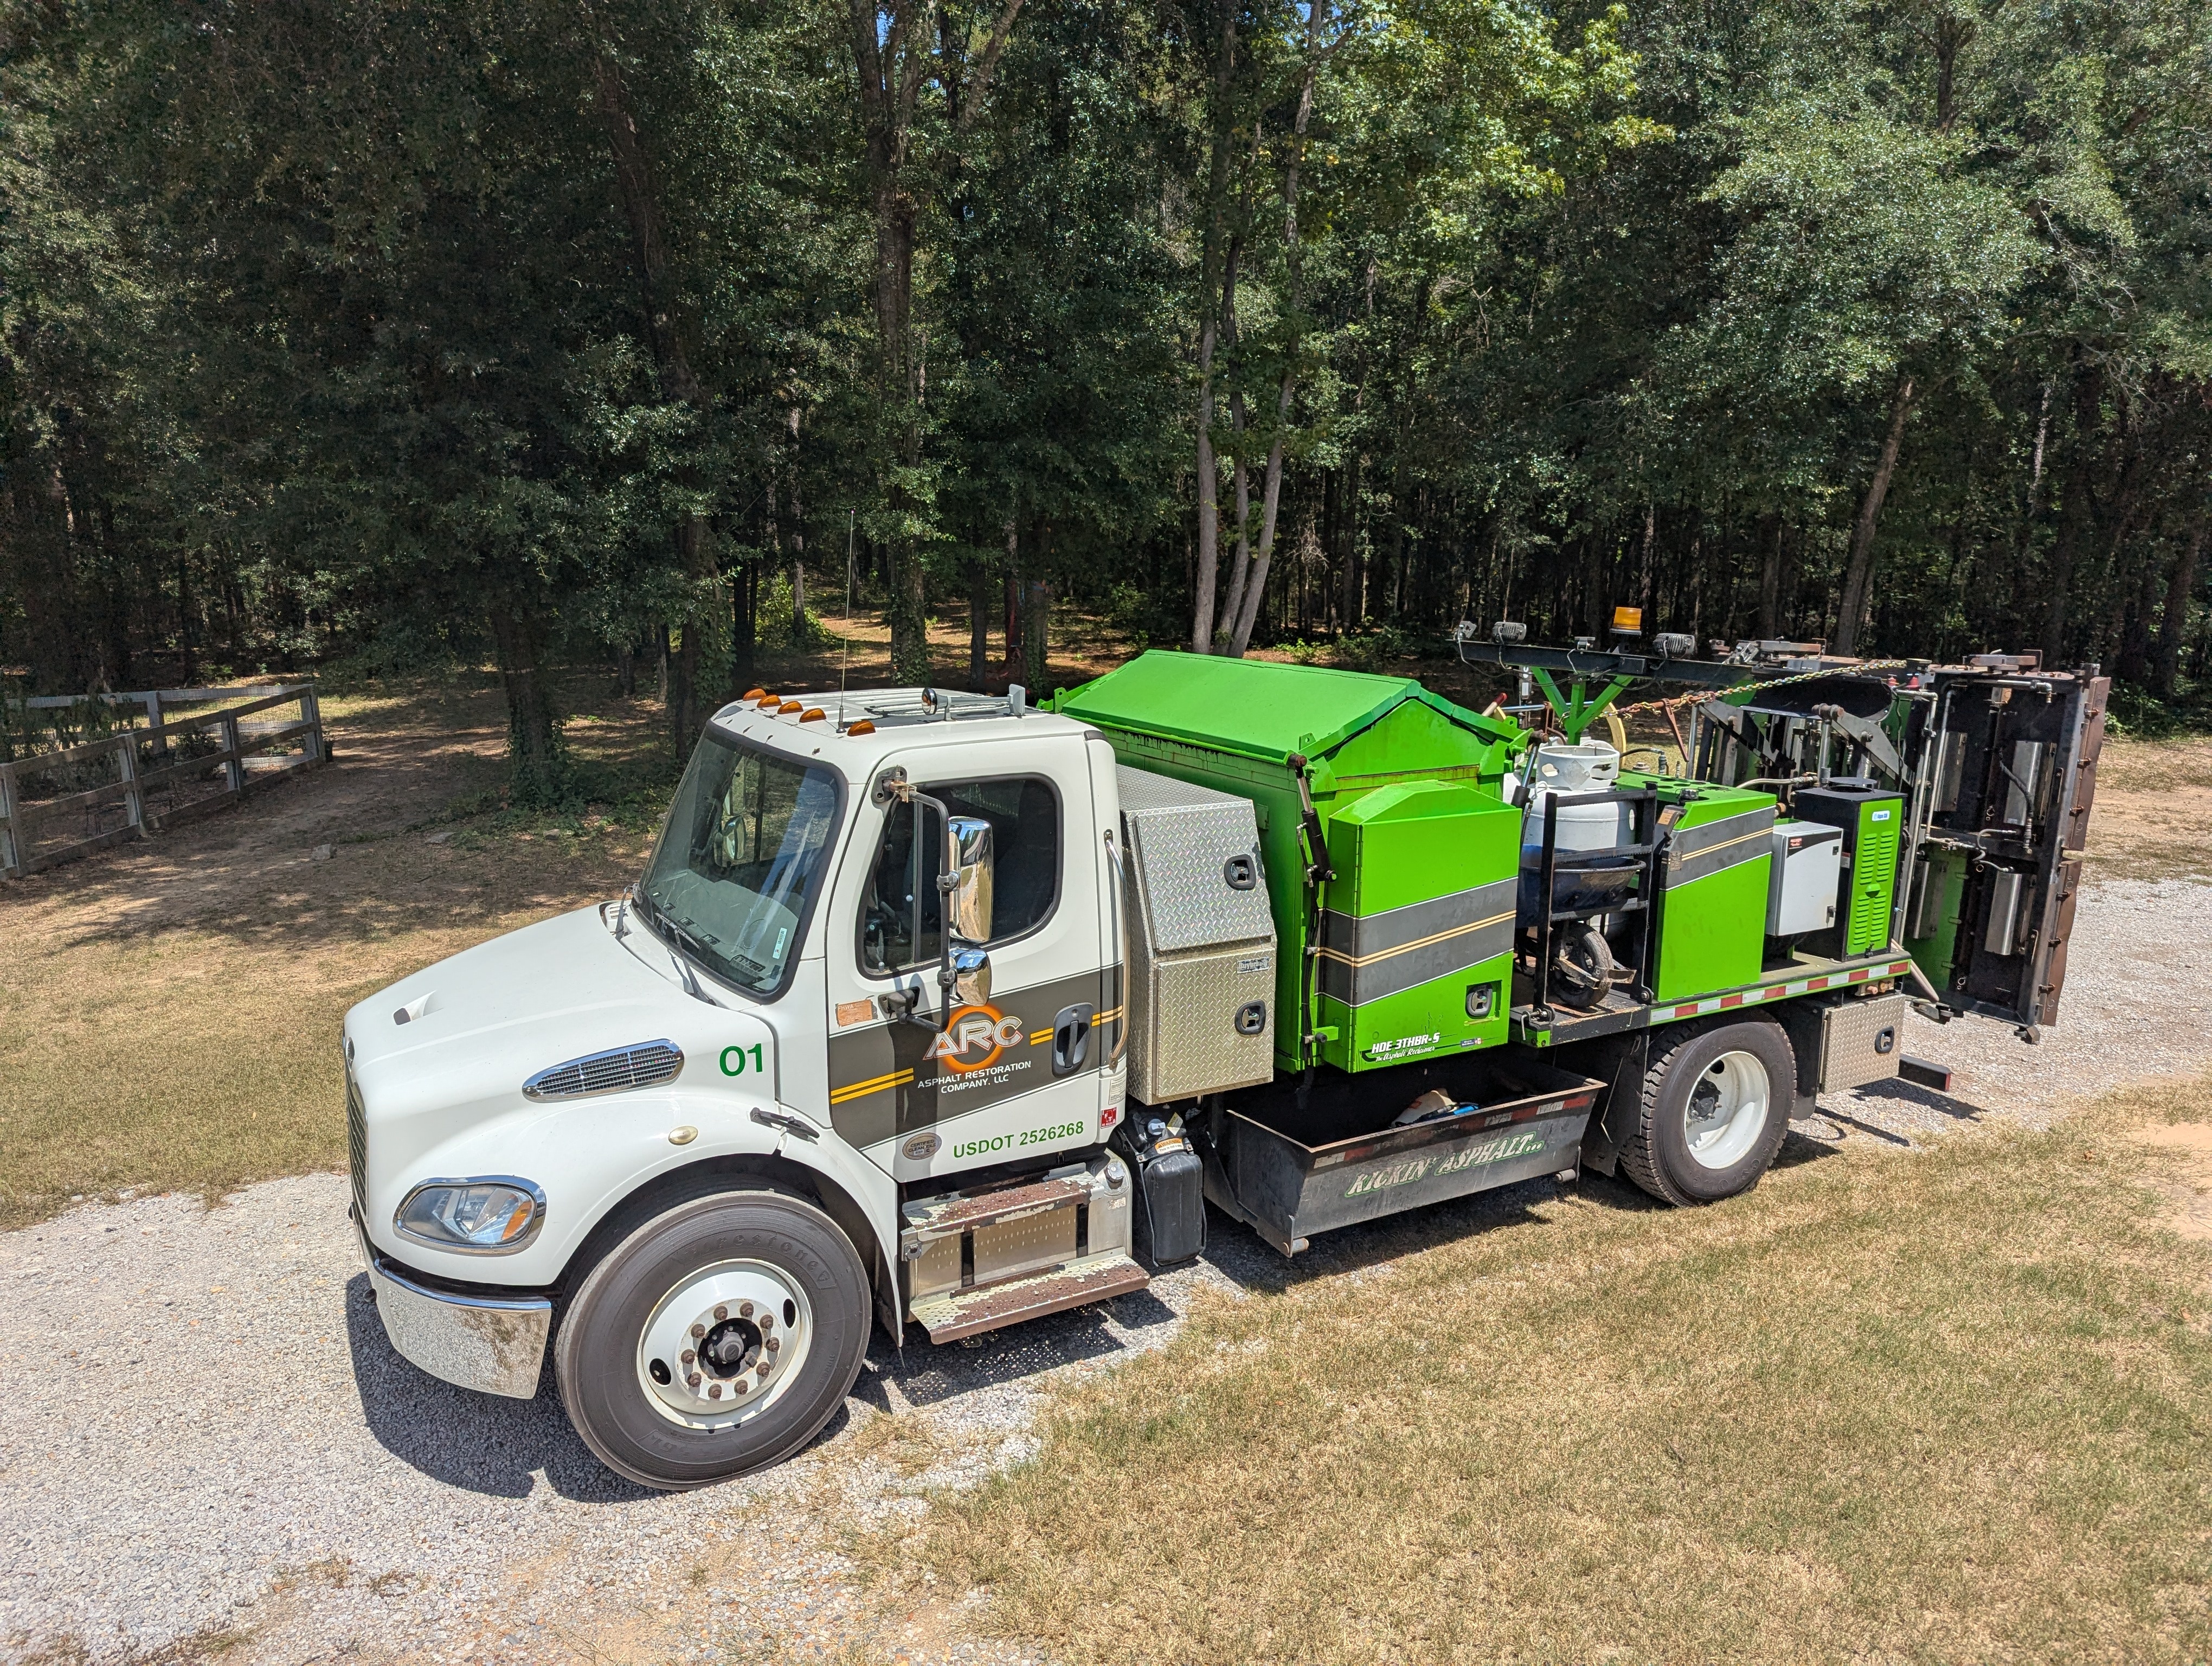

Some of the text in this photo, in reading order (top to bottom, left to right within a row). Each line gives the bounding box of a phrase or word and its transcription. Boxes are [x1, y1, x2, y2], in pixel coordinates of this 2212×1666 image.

[923, 1016, 1024, 1060] ARC
[1371, 1032, 1441, 1054] HDE 3THBR-S
[719, 1043, 763, 1077] 01
[917, 1060, 1032, 1088] ASPHALT RESTORATION
[994, 1074, 1009, 1084] LLC
[954, 1120, 1084, 1158] USDOT 2526268
[1346, 1157, 1436, 1195] KICKIN'
